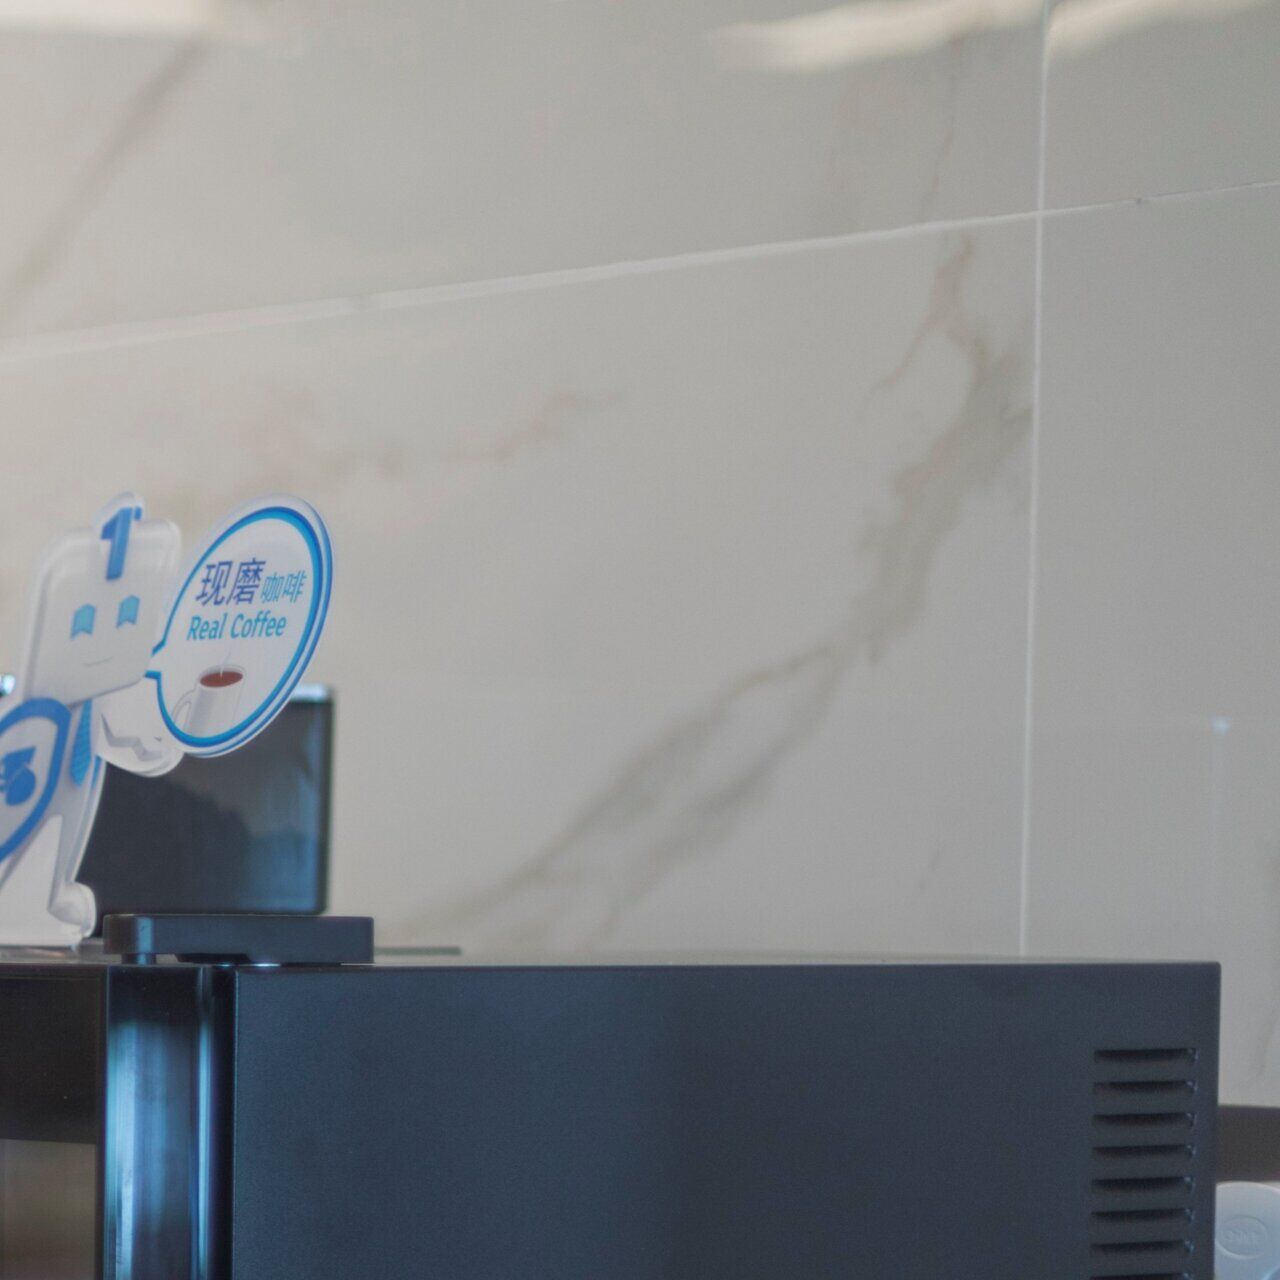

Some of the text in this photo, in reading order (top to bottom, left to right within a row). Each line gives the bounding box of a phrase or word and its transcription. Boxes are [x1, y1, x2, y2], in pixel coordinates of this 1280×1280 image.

[195, 557, 308, 606] 现磨咖啡
[186, 609, 287, 641] Real Coffee
